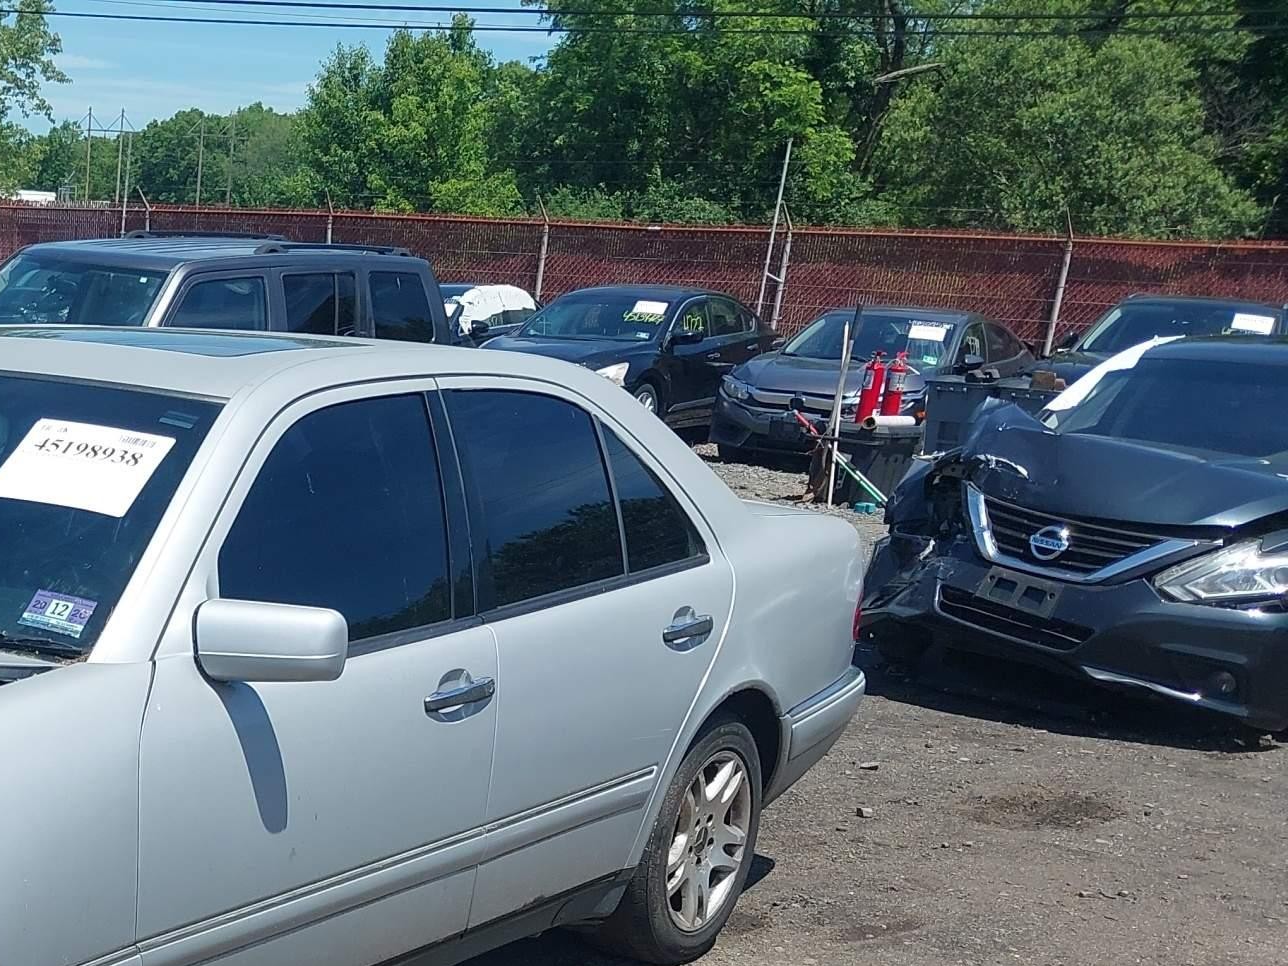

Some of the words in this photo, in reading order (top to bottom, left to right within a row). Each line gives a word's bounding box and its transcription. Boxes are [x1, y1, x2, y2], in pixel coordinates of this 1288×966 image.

[34, 438, 143, 466] 45198938
[1031, 536, 1064, 549] NISSAN
[49, 602, 70, 617] 12
